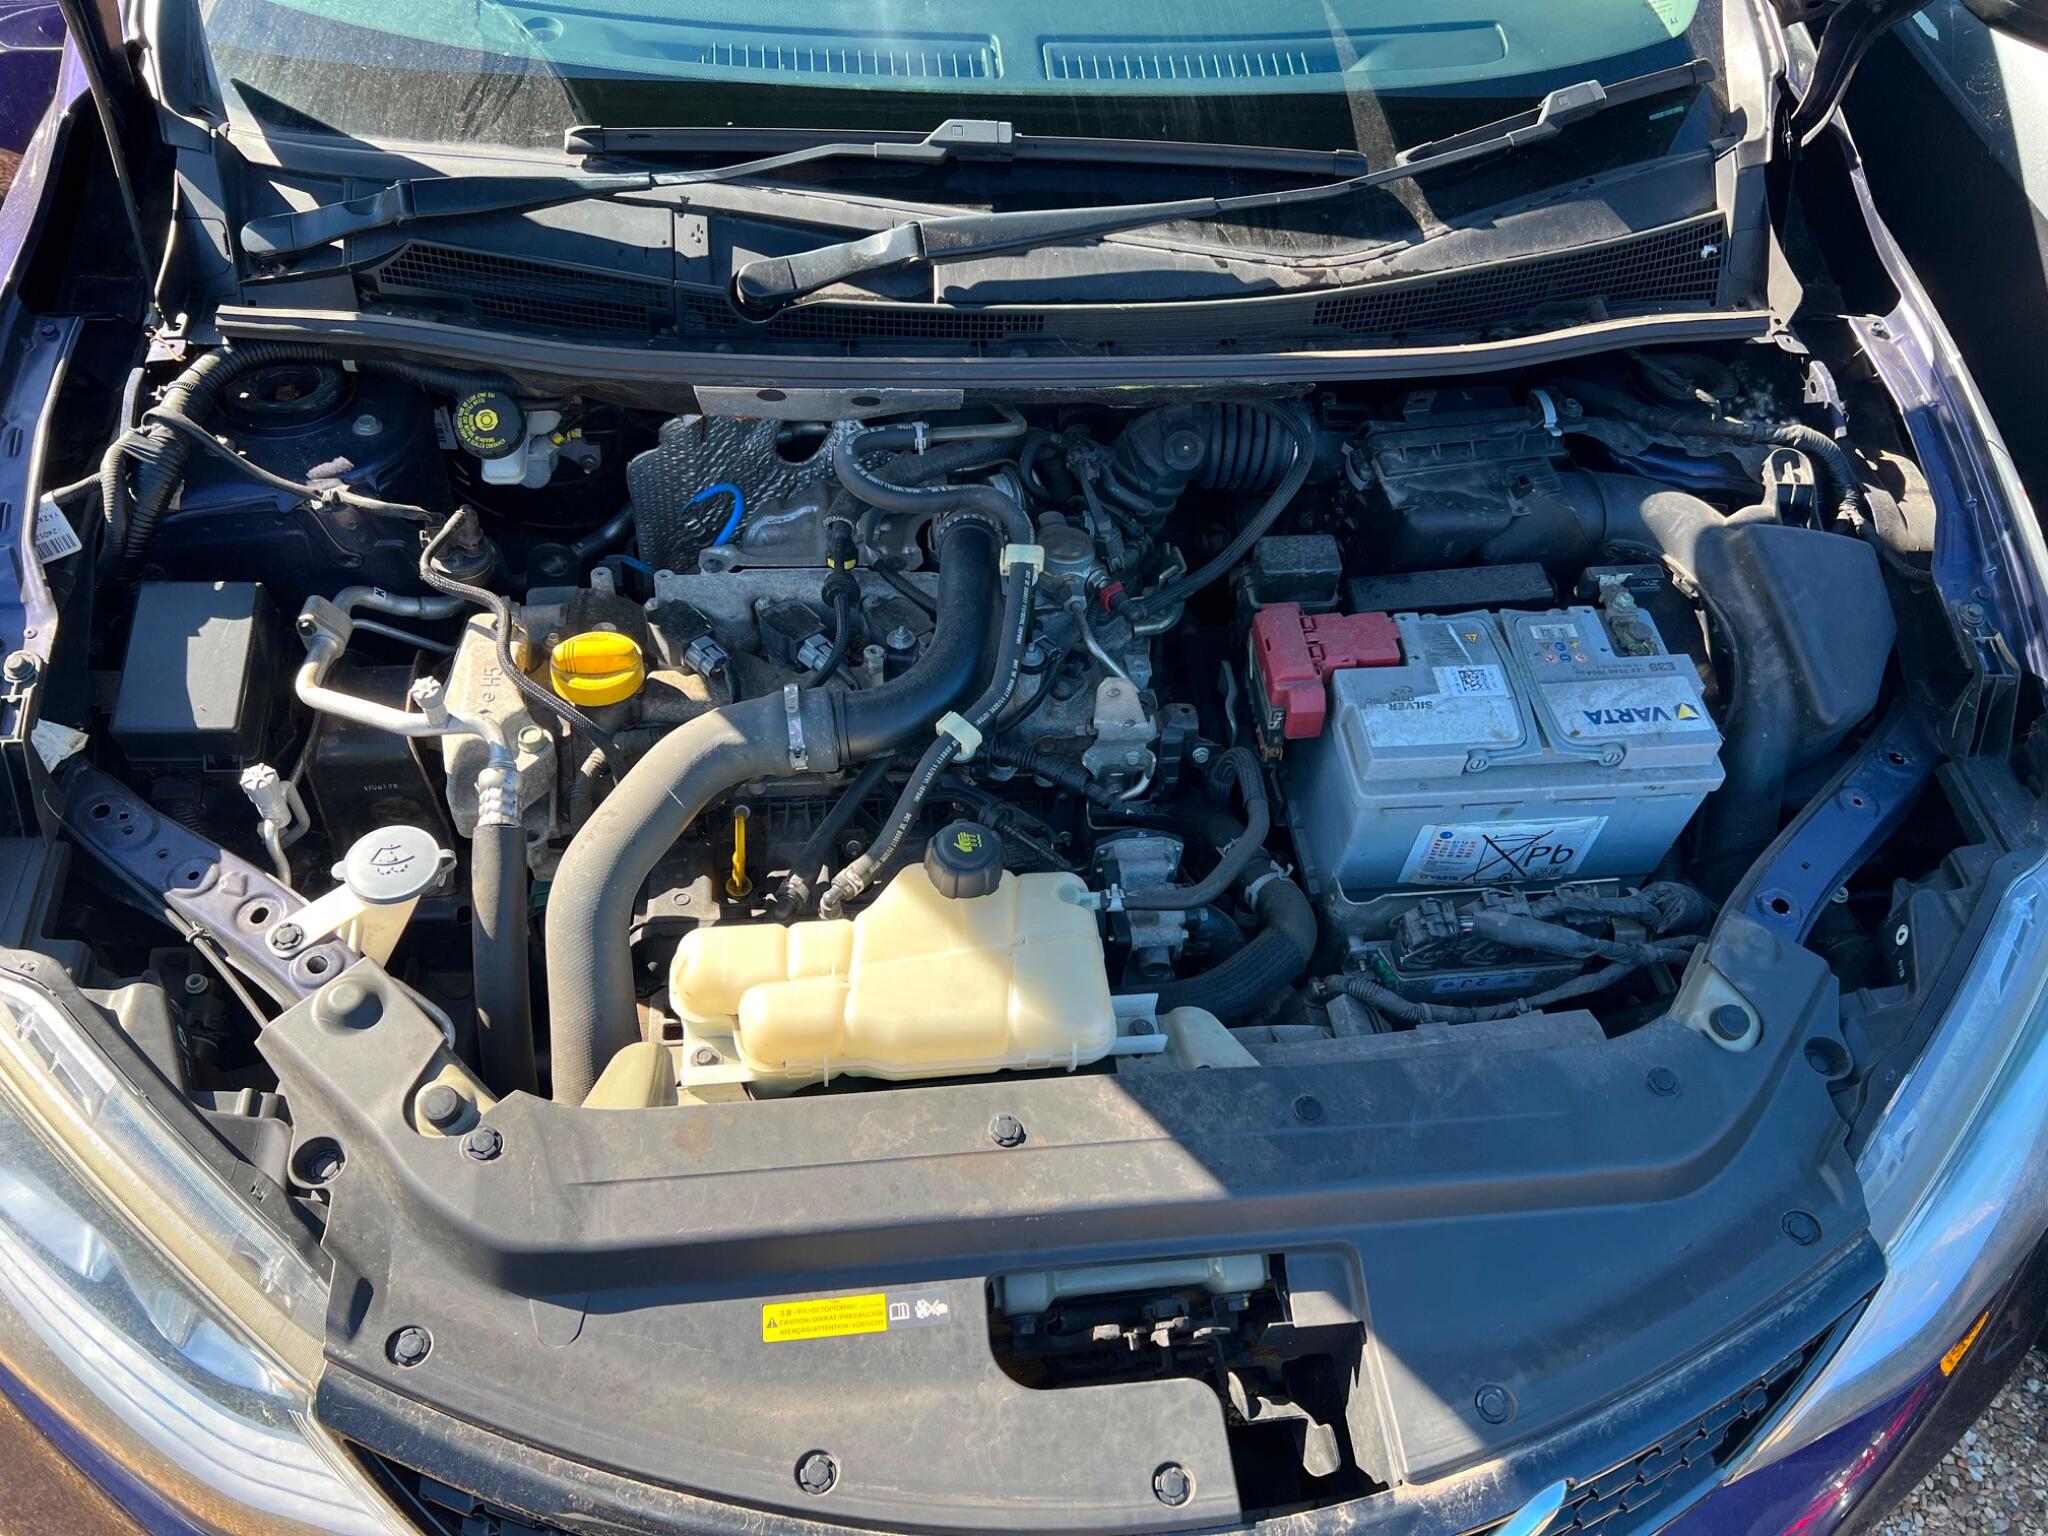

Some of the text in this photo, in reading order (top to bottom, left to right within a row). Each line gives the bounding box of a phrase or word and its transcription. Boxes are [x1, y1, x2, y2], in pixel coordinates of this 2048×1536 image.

[1388, 701, 1433, 711] SILVER
[1583, 706, 1672, 725] VARTA
[1523, 844, 1574, 867] Pb
